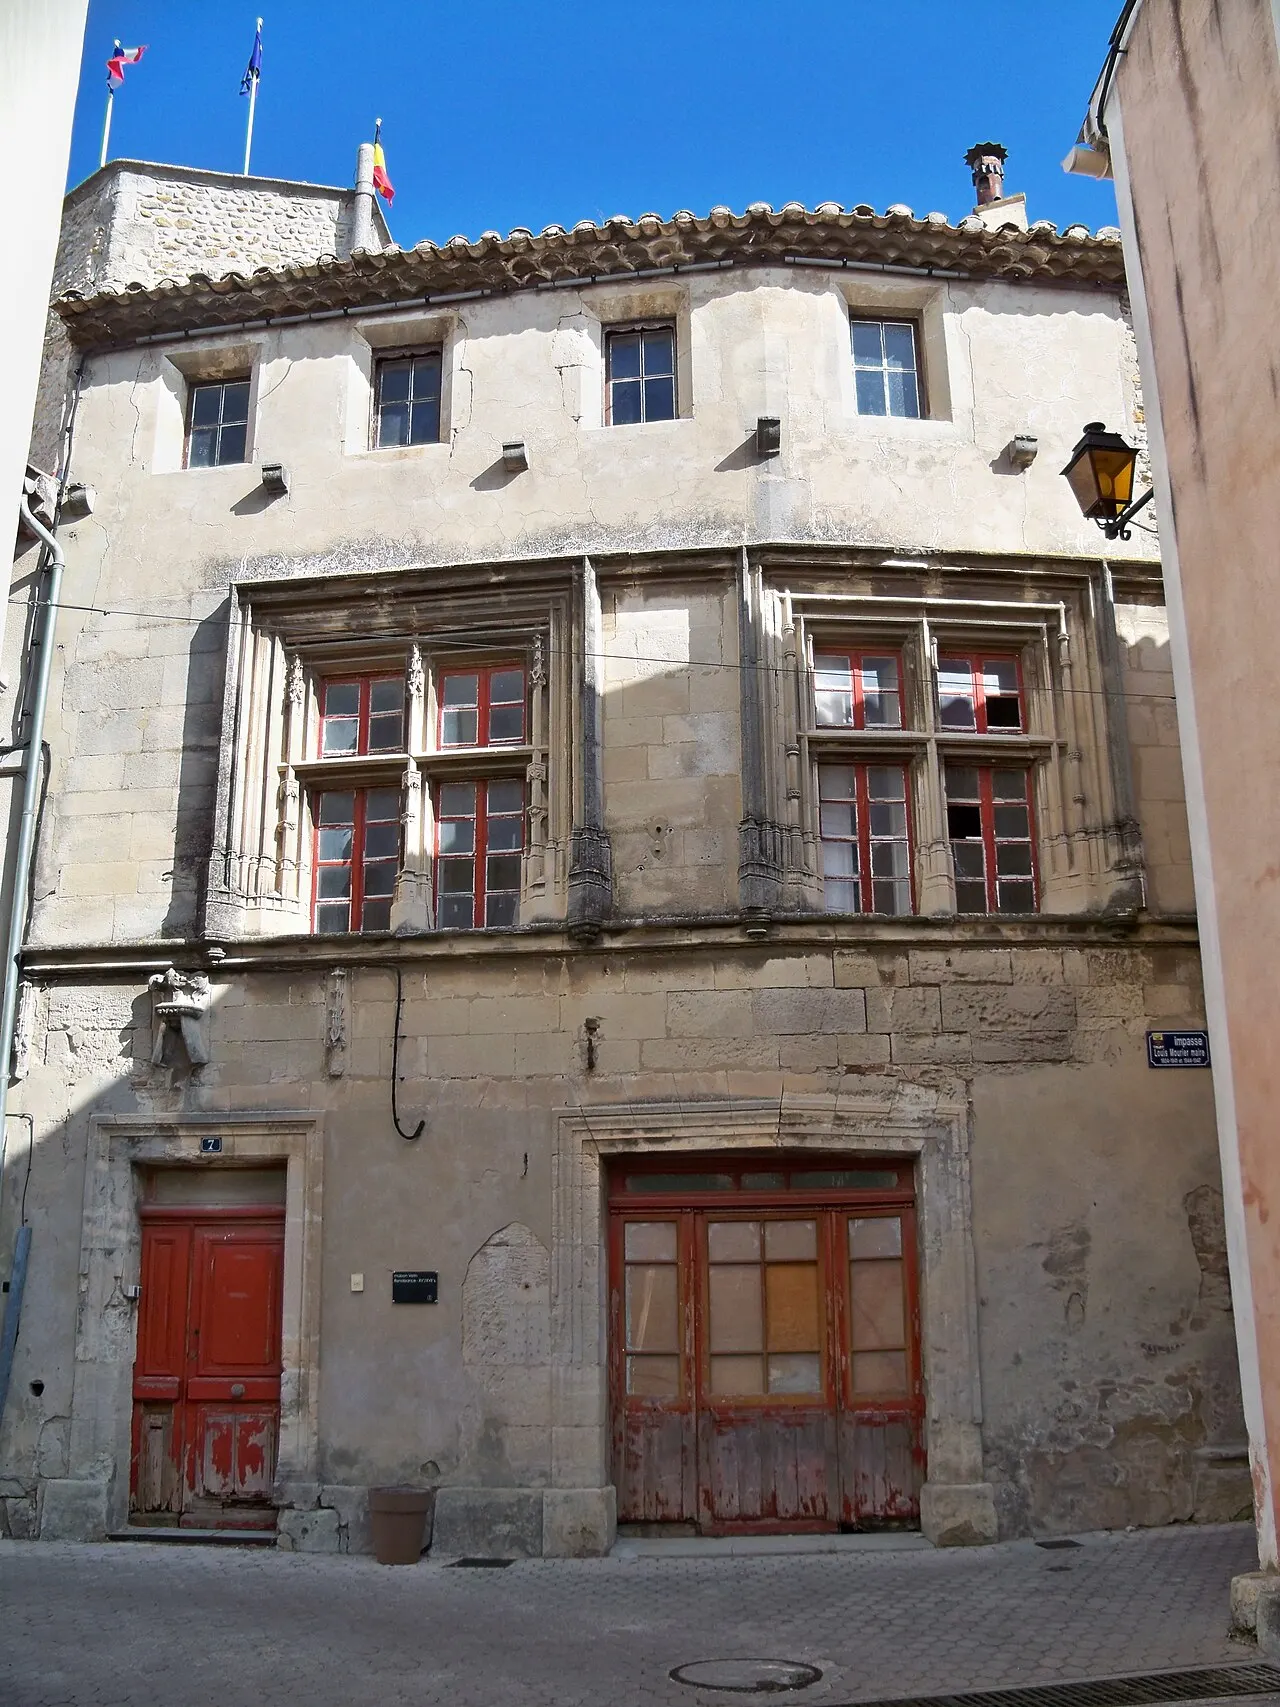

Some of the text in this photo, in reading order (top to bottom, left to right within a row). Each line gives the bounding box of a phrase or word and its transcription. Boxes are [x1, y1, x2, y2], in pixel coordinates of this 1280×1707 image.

[1153, 1048, 1168, 1057] Louis
[1190, 1048, 1206, 1057] maire
[207, 1139, 215, 1150] 7
